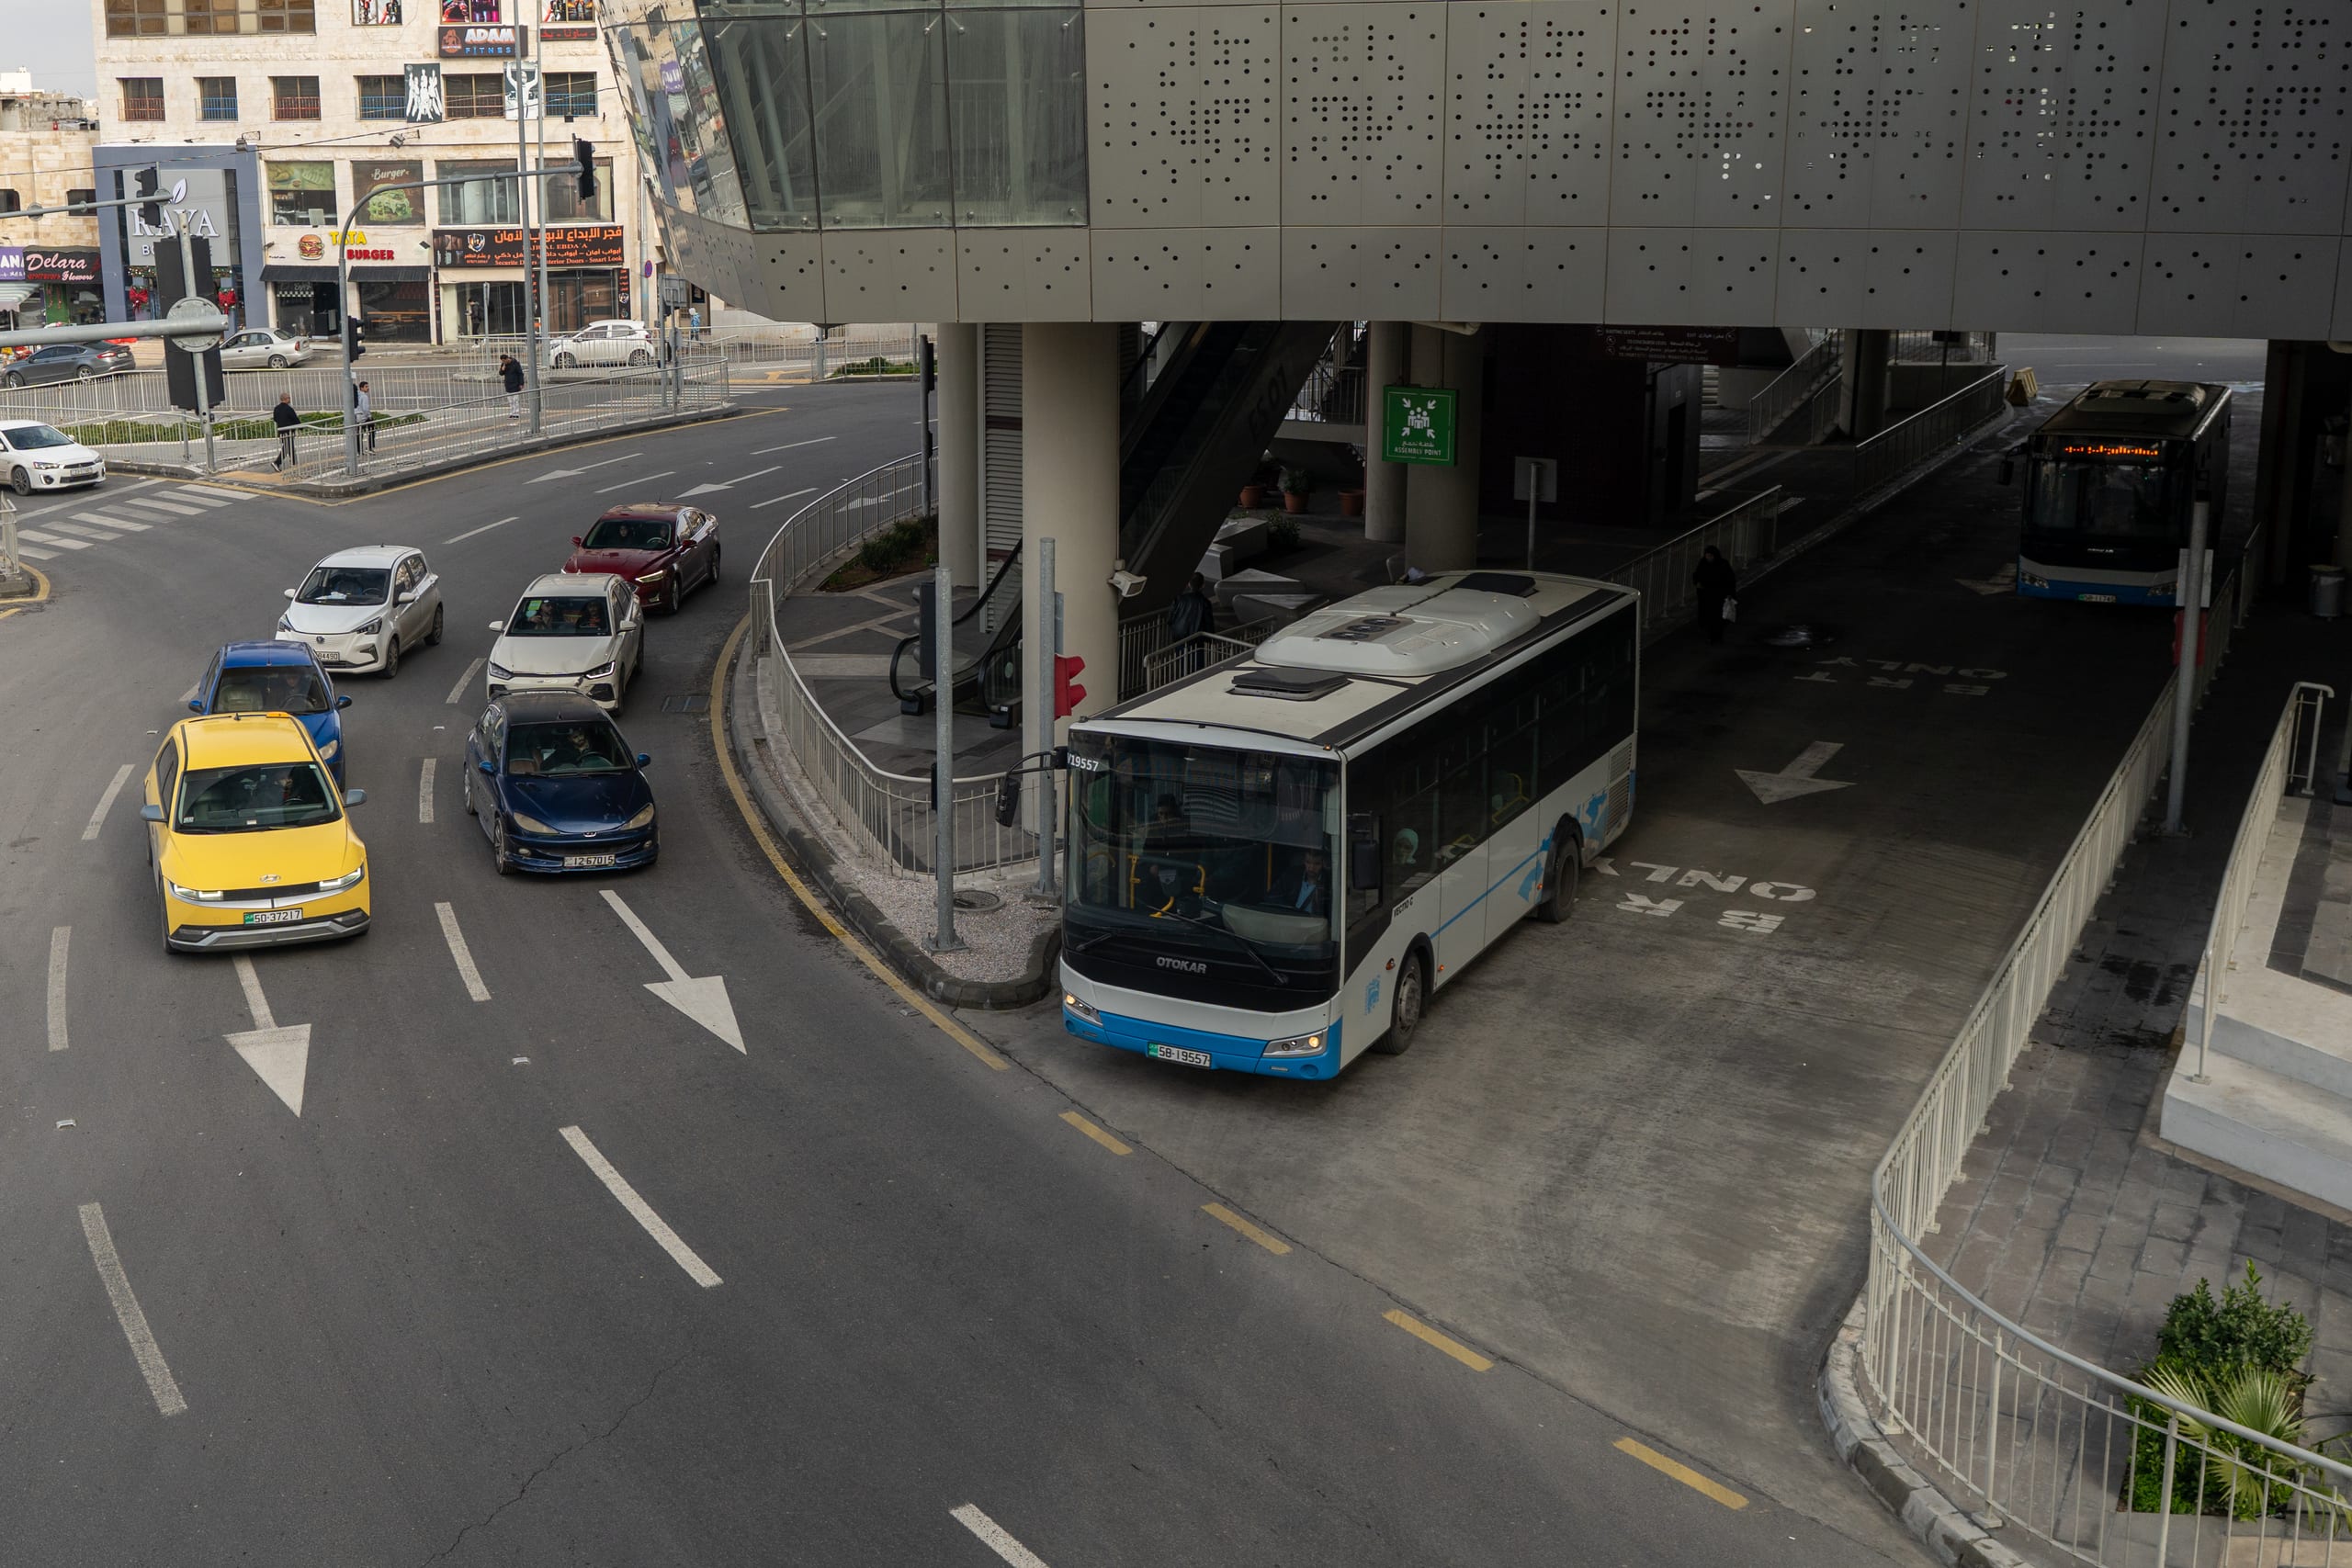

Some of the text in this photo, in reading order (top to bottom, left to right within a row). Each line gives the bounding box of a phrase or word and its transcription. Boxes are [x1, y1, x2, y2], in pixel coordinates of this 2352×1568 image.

[465, 28, 515, 44] ADAM
[465, 46, 516, 55] FITNES
[373, 168, 406, 181] Burger
[329, 231, 368, 245] TATA
[603, 226, 623, 241] فجر
[26, 253, 87, 271] Delara
[346, 249, 394, 261] BURGER
[1395, 446, 1423, 455] ASSEMBLY
[1815, 656, 2007, 681] ONLY
[1067, 752, 1099, 772] V19557
[254, 910, 300, 923] 50-37217
[1156, 956, 1207, 974] OTOKAR
